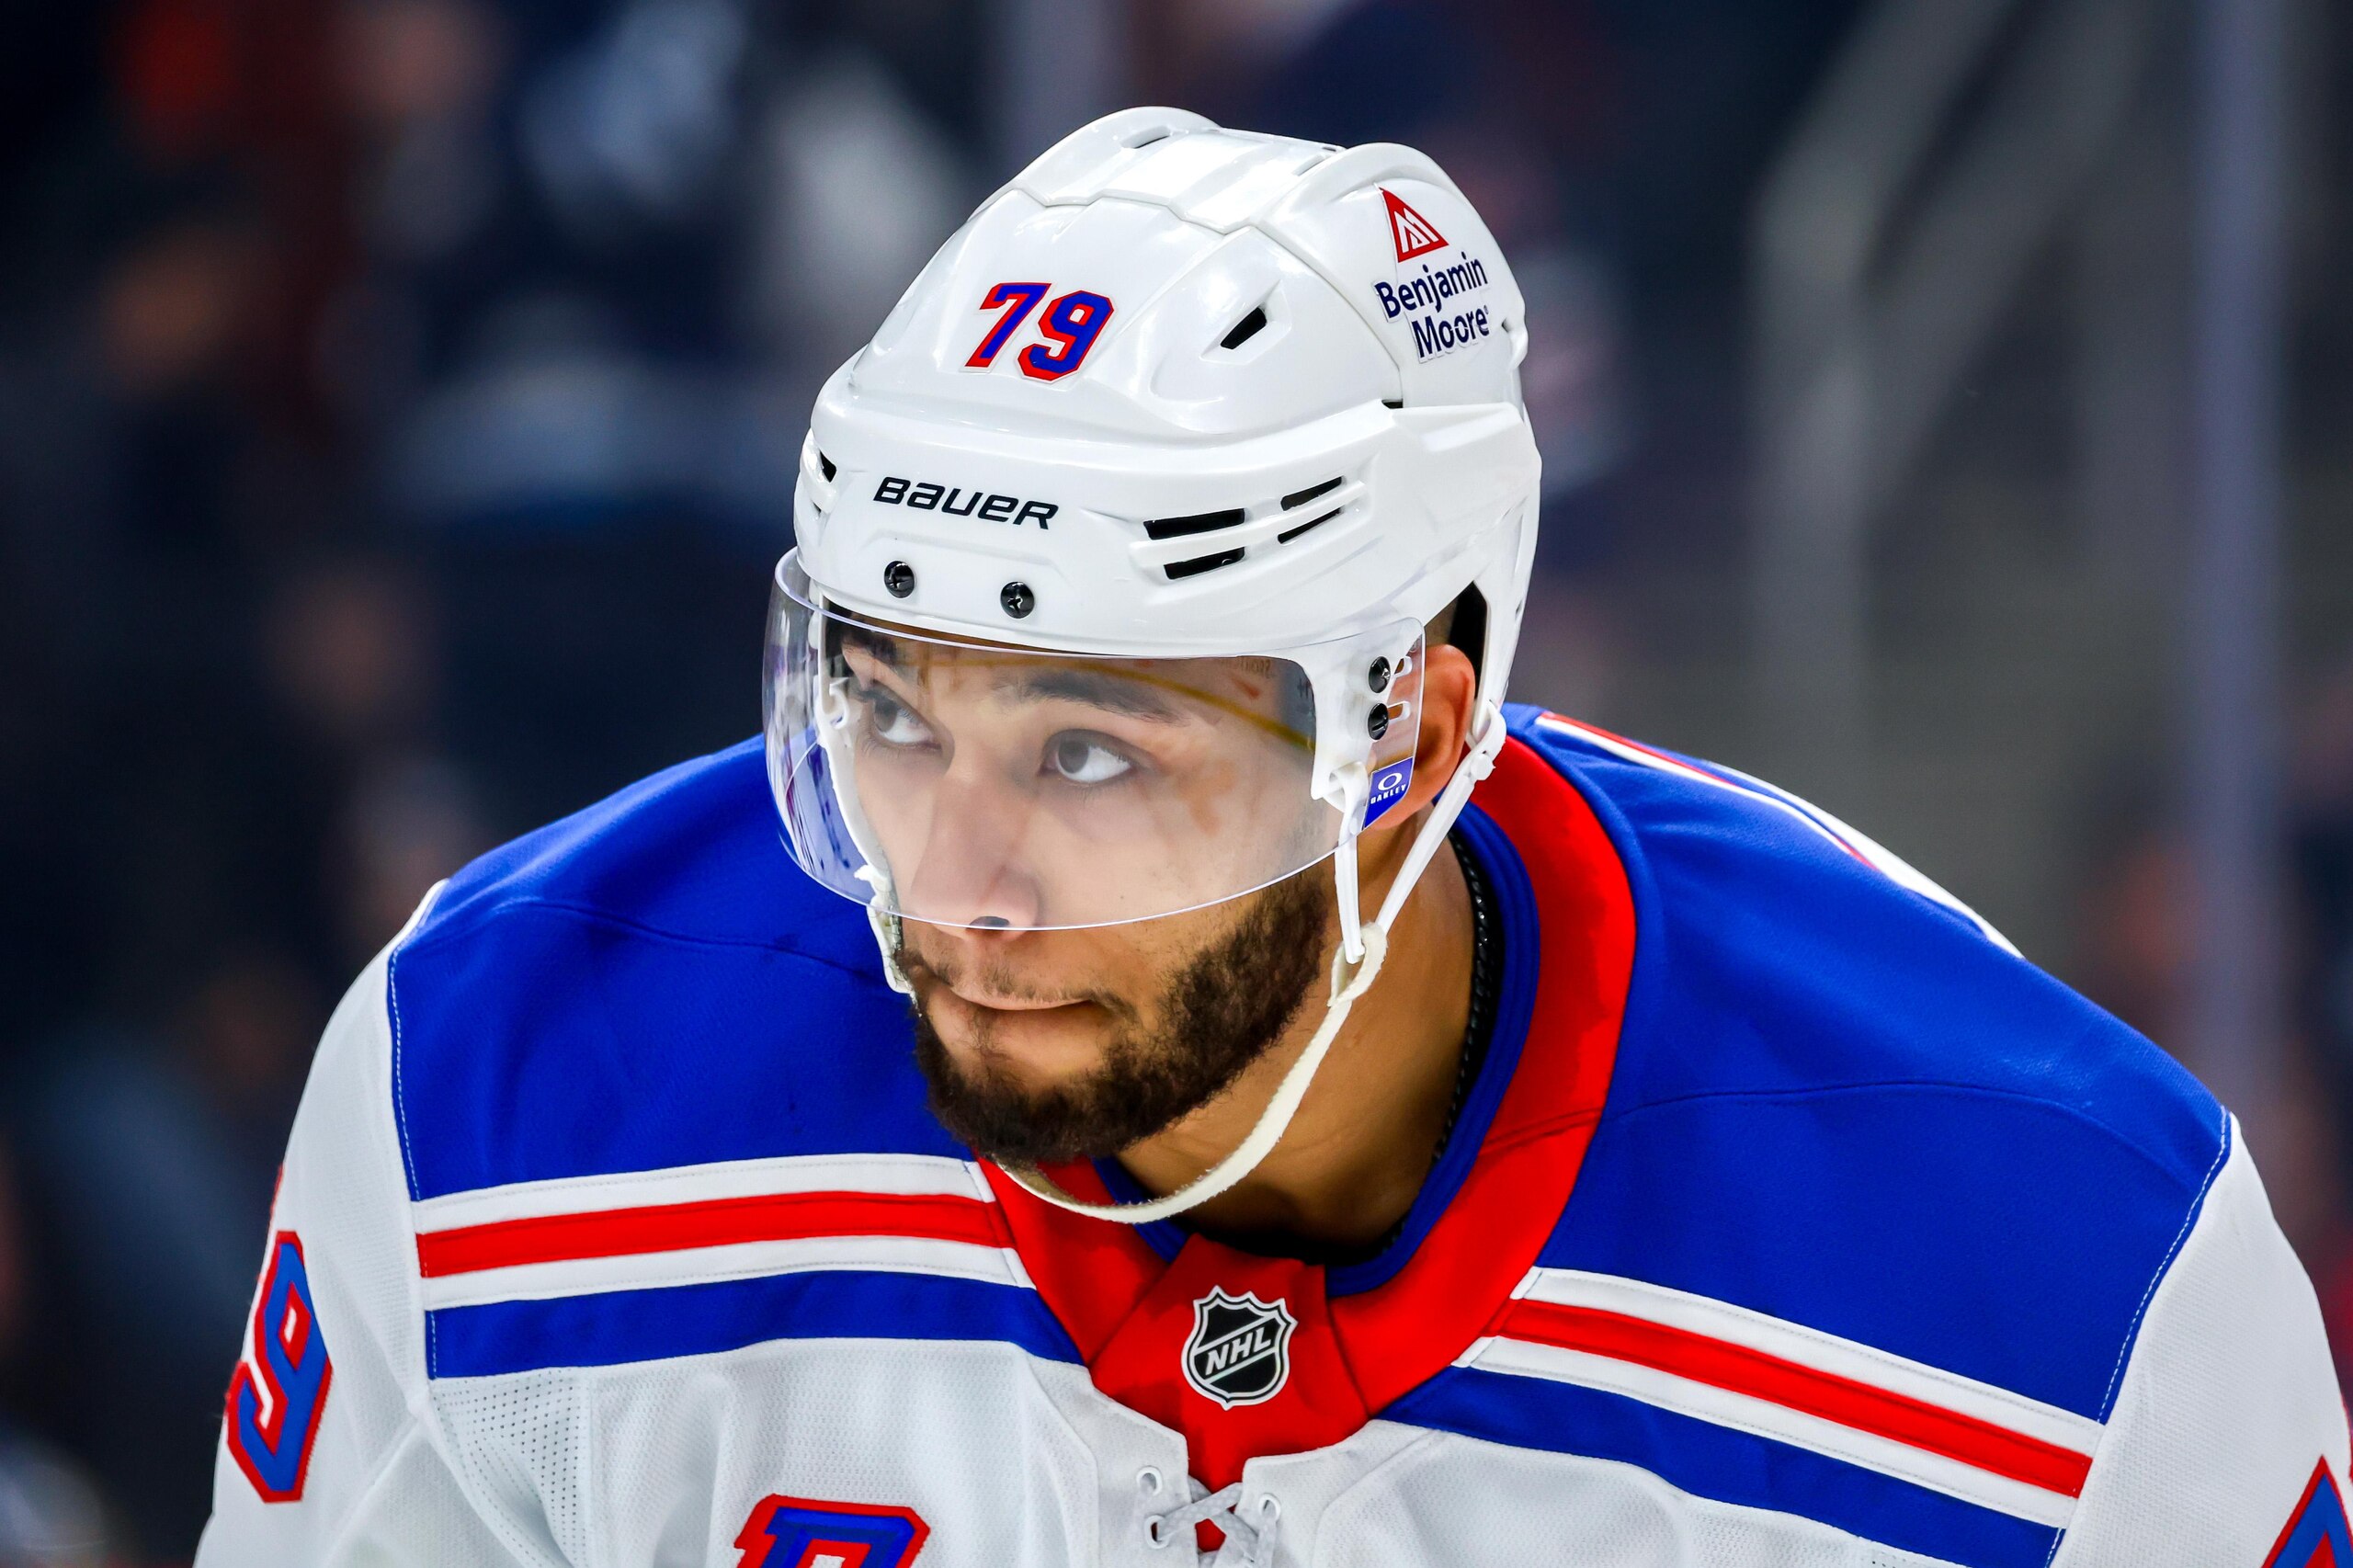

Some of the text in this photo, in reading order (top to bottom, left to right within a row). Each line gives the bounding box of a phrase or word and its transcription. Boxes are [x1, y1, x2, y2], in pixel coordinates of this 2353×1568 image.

[1375, 251, 1488, 319] Benjamin
[965, 281, 1114, 381] 79
[873, 476, 1059, 529] BAUER
[1370, 783, 1406, 804] OAKLEY
[224, 1229, 334, 1504] 9
[1205, 1326, 1271, 1376] NHL
